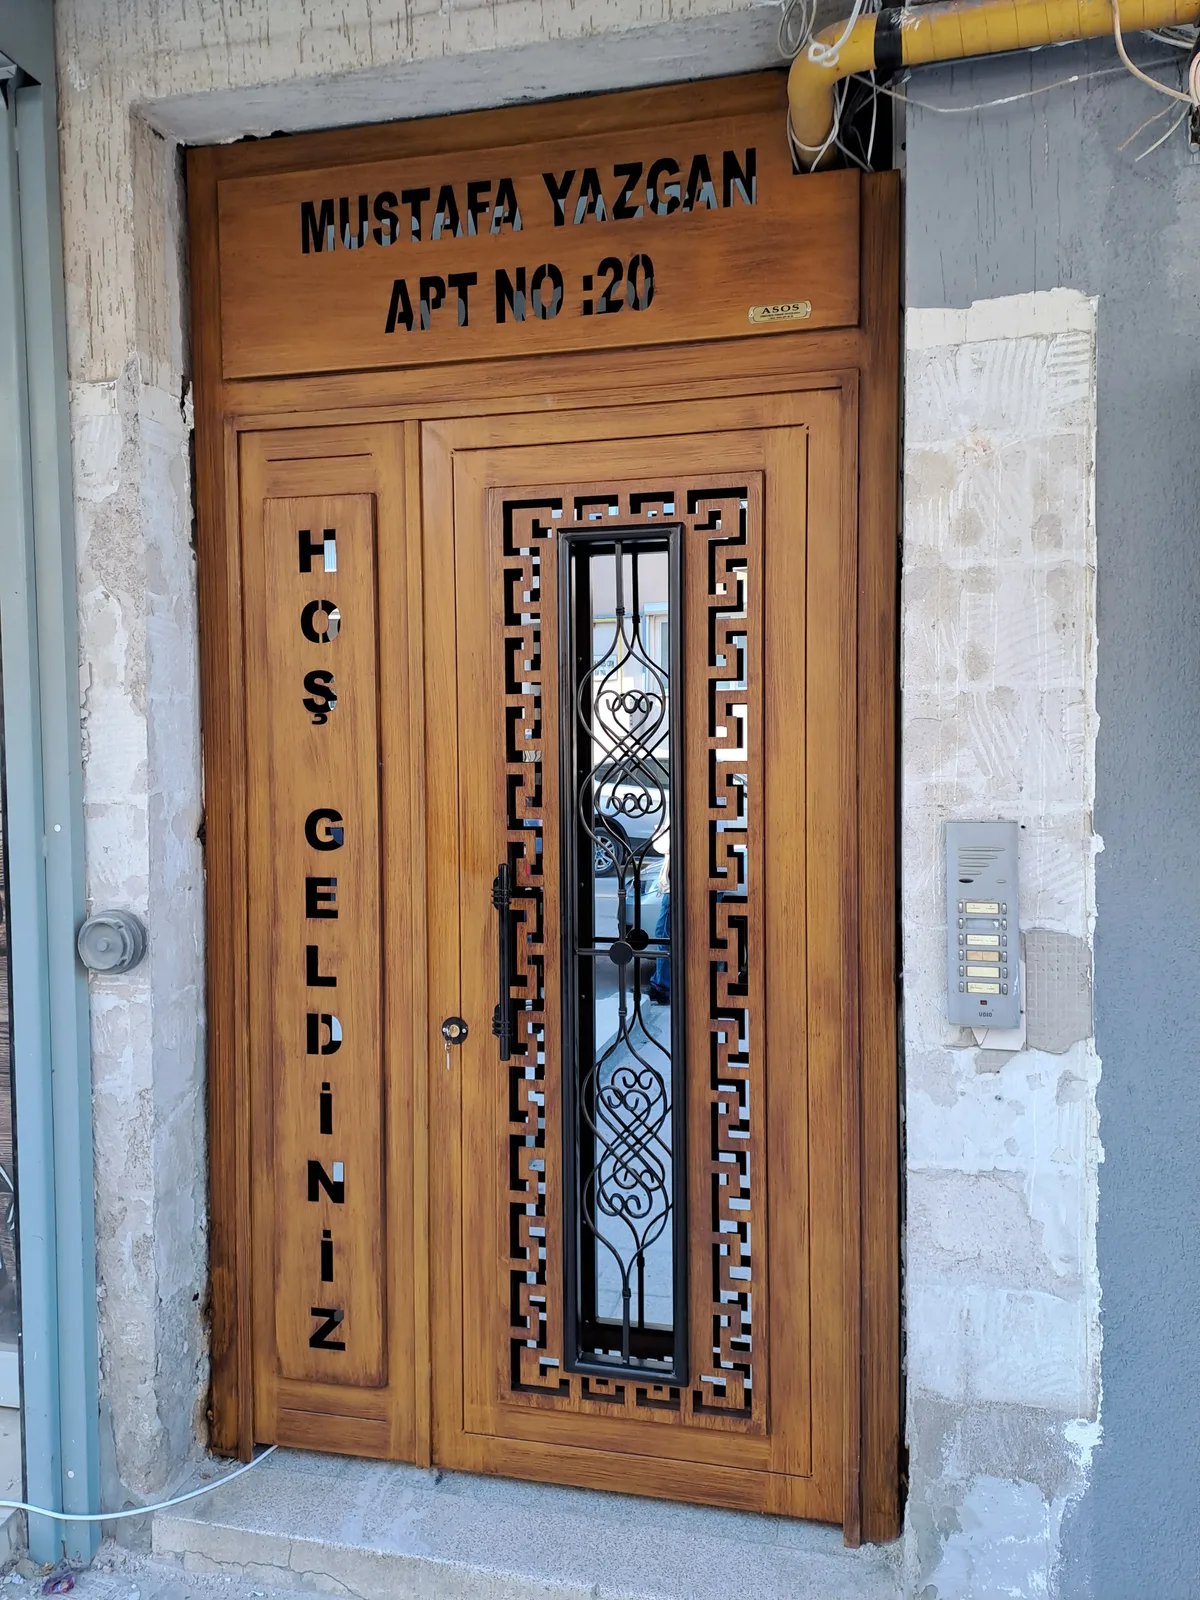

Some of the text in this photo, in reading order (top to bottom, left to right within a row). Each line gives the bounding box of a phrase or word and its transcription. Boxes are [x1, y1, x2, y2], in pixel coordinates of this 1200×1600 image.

[301, 147, 757, 254] MUSTAFA YAZGAN
[384, 271, 478, 334] APT
[495, 263, 564, 324] NO
[762, 304, 800, 314] ASOS
[298, 528, 347, 1352] HOŞ GELDİNİZ
